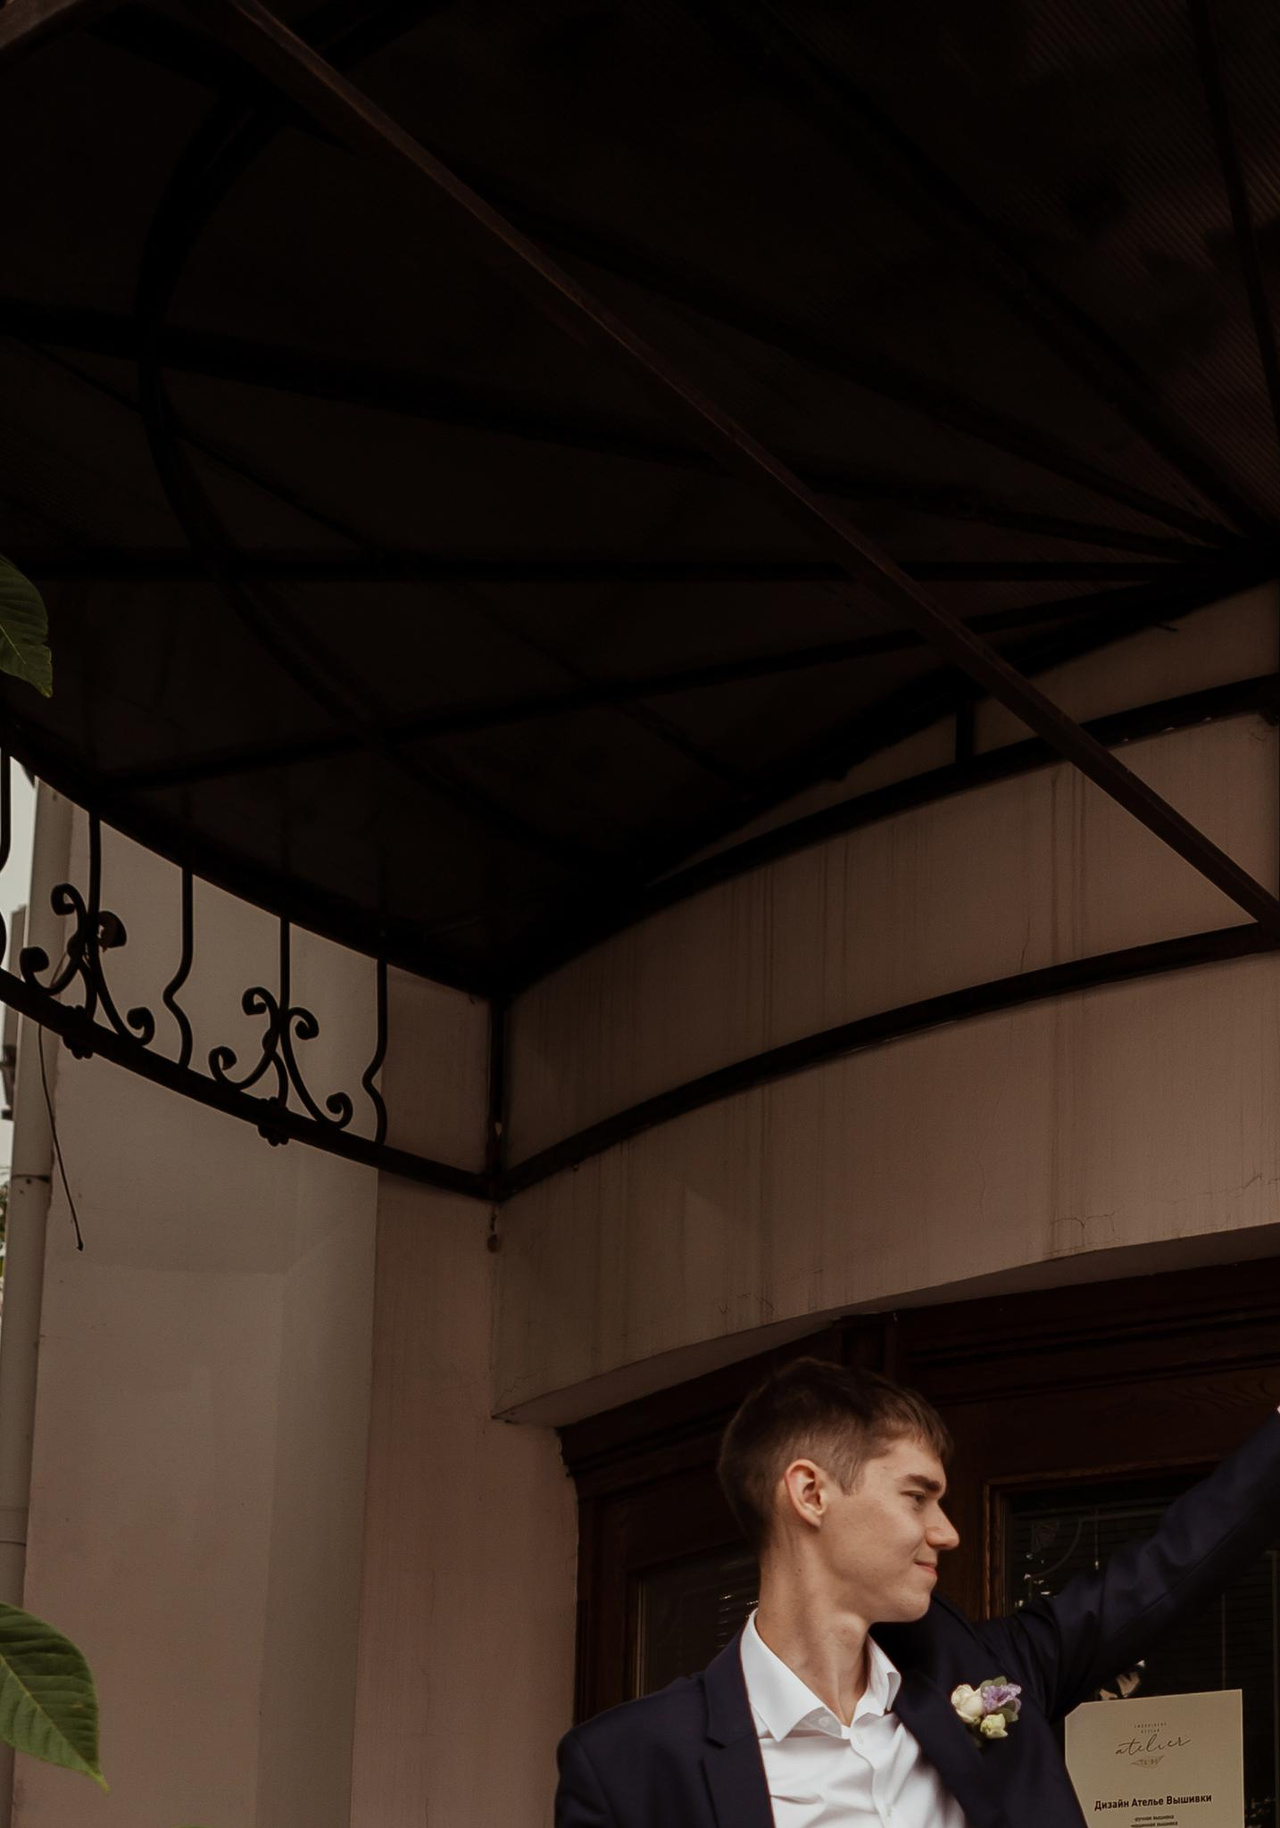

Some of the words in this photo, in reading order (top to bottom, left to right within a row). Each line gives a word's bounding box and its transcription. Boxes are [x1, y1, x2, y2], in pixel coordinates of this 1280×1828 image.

[1115, 1733, 1191, 1756] atelier
[1094, 1799, 1129, 1811] Дизайн
[1131, 1798, 1164, 1807] Ателье
[1166, 1795, 1212, 1805] Вышивки
